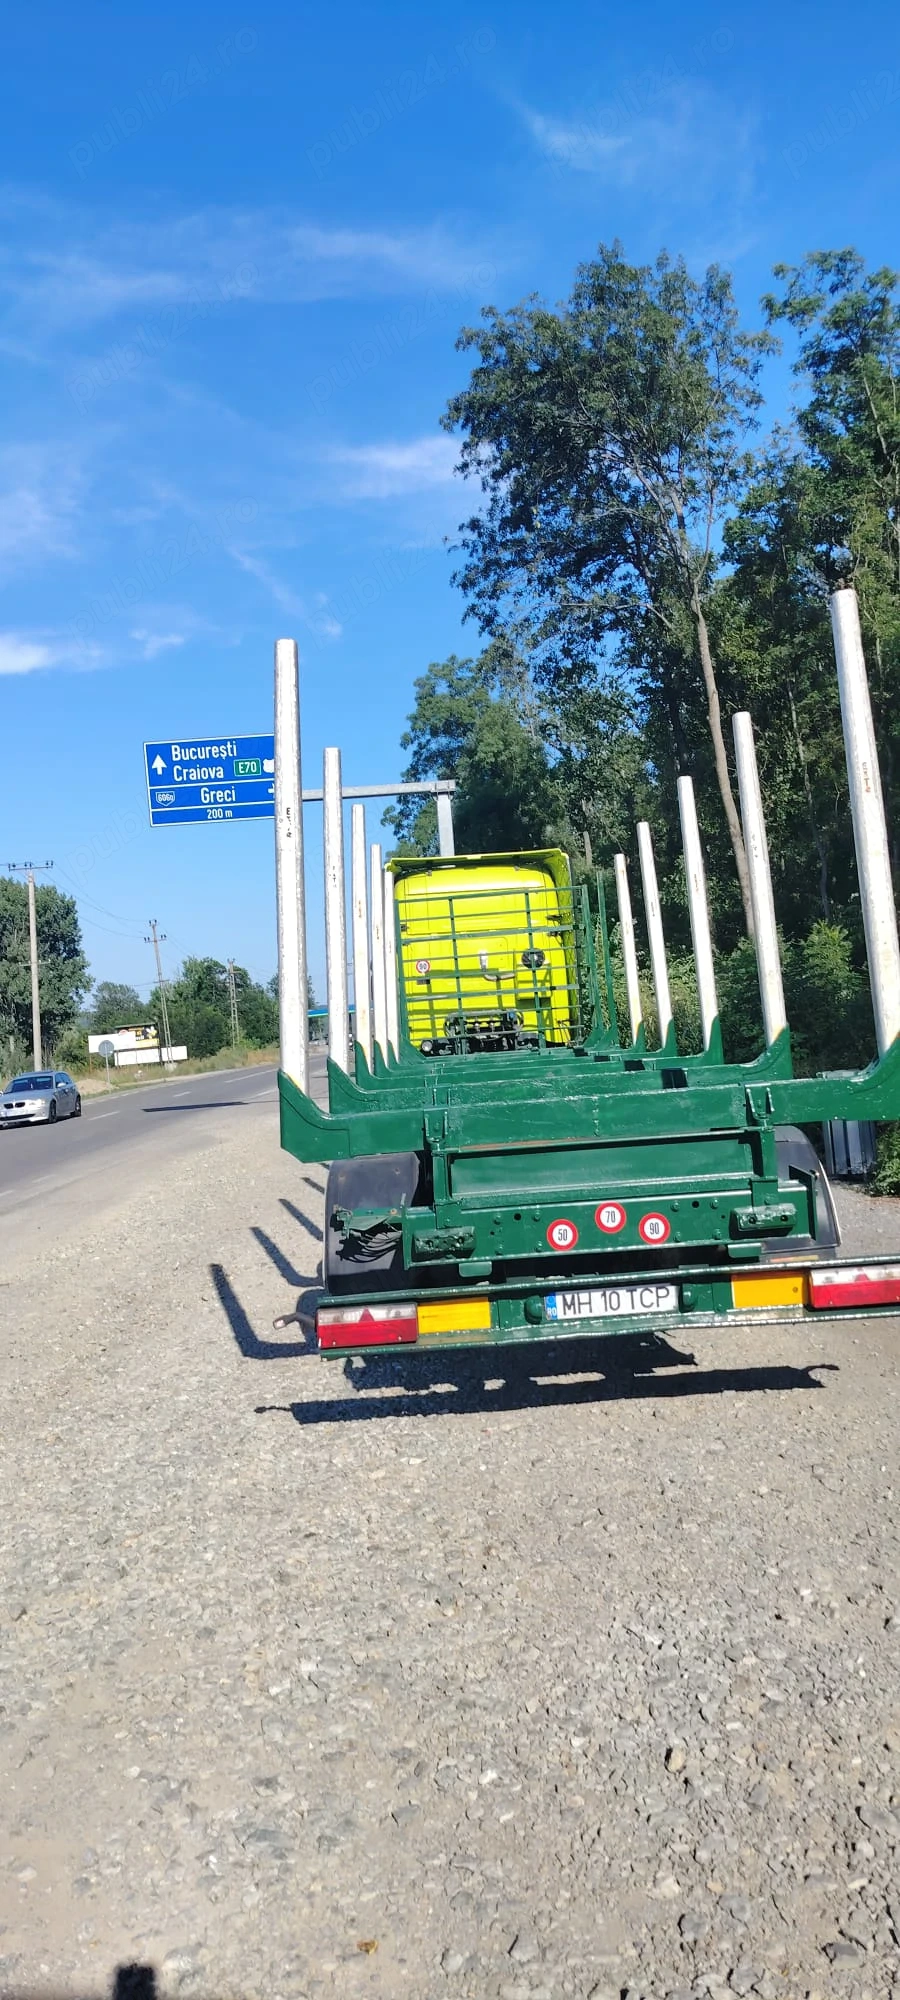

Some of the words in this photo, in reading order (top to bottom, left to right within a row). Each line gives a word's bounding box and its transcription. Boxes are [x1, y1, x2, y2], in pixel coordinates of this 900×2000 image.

[173, 764, 224, 782] Craiova
[238, 761, 257, 774] E70
[200, 786, 236, 804] Greci
[206, 808, 223, 820] 200
[225, 810, 233, 818] m
[605, 1210, 616, 1224] 70
[557, 1228, 568, 1241] 50
[649, 1222, 660, 1235] 90
[562, 1291, 593, 1316] MH
[600, 1290, 620, 1312] 10
[626, 1286, 671, 1311] TCP
